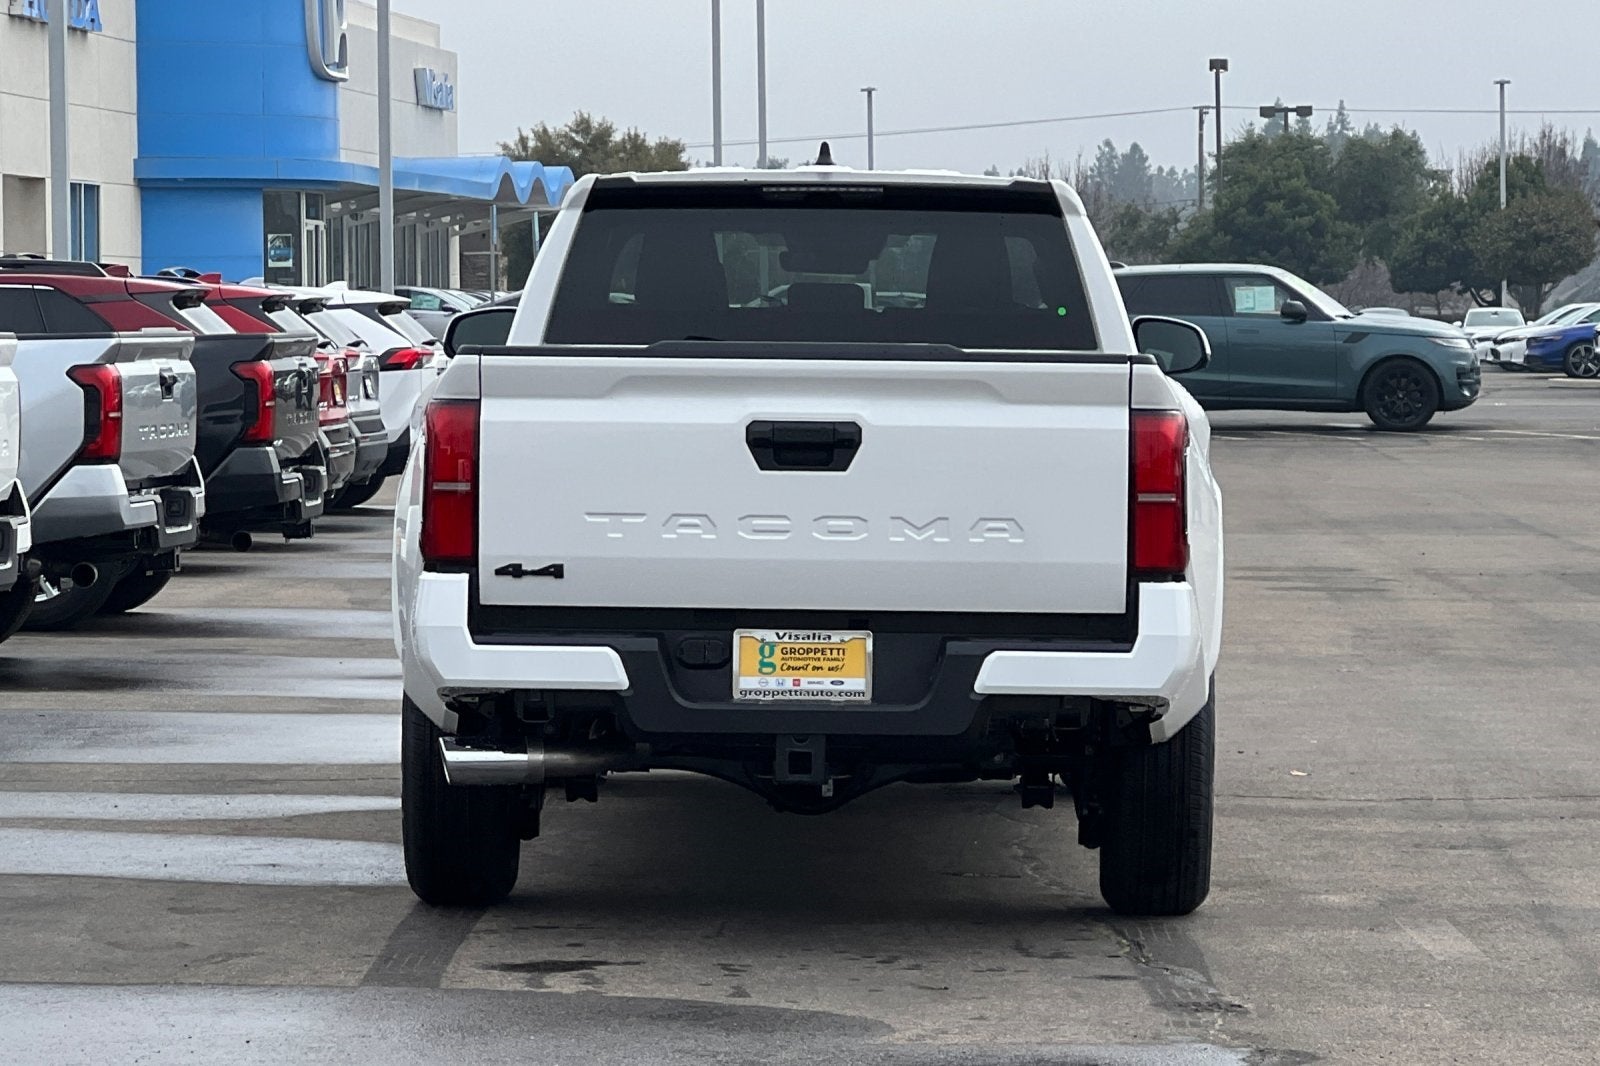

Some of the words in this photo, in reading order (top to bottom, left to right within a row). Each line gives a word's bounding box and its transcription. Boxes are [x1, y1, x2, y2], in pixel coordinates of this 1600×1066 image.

[585, 512, 1024, 543] TACOMA
[775, 632, 832, 641] Visalia
[781, 647, 846, 656] GROPPETTI
[780, 663, 810, 672] Count
[827, 663, 846, 673] us!
[740, 689, 866, 699] groppettiauto.com
